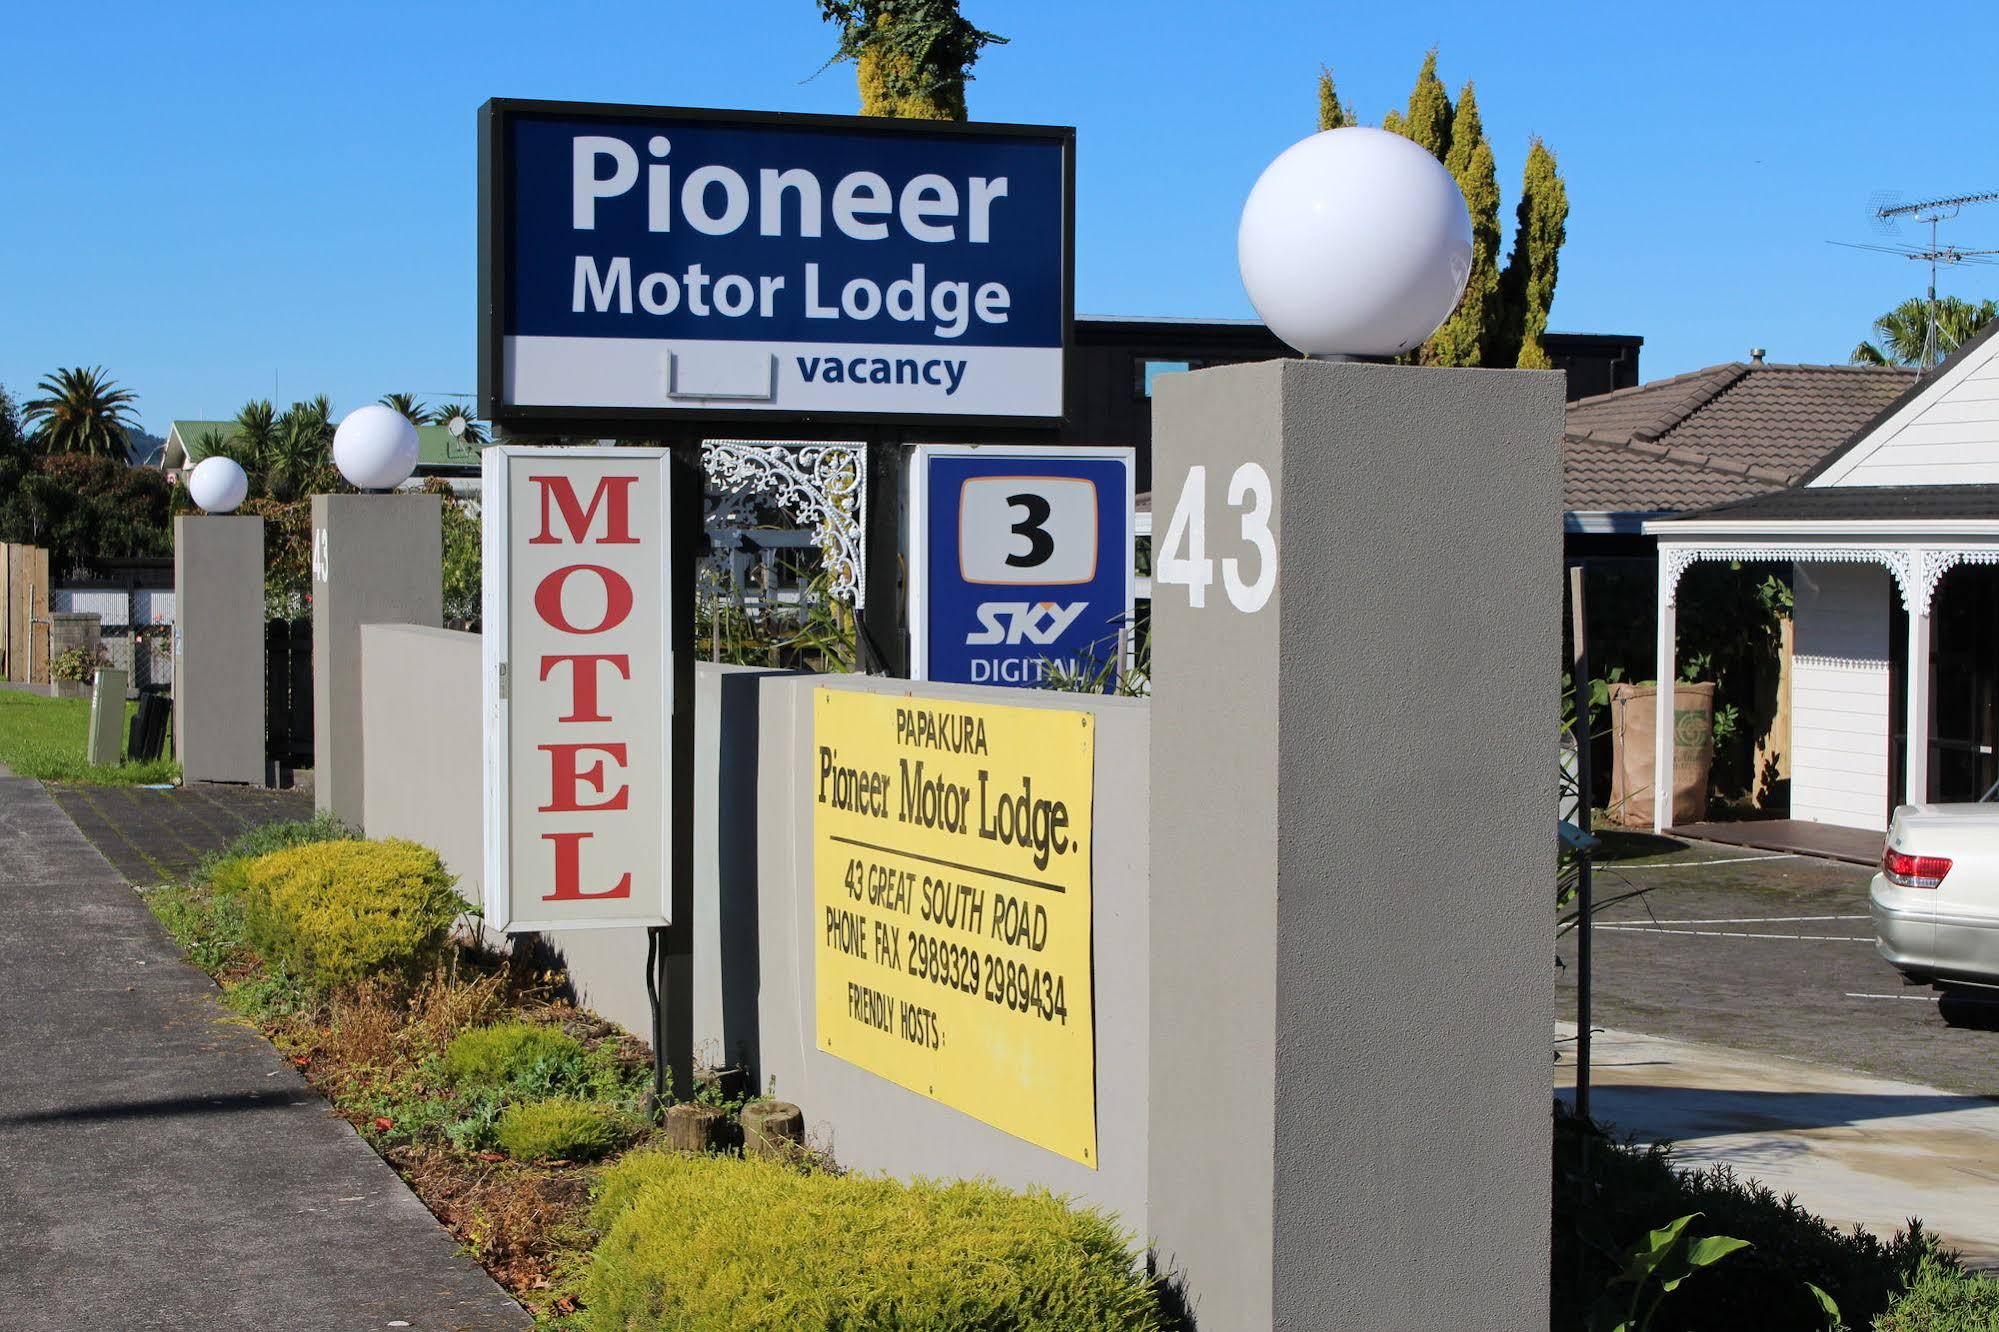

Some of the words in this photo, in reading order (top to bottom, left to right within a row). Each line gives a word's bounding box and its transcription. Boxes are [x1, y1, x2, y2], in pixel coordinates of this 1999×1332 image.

[572, 136, 1008, 243] Pioneer
[571, 255, 785, 317] Motor
[804, 263, 1011, 339] Lodge
[796, 355, 968, 396] vacancy
[312, 528, 329, 582] 43
[1004, 493, 1055, 568] 3
[1156, 462, 1277, 613] 43
[965, 601, 1090, 645] SKY
[528, 476, 641, 902] MOTEL
[896, 708, 988, 756] PAPAKURA
[818, 746, 891, 819] Pioneer
[898, 758, 971, 835] Motor
[844, 859, 864, 901] 43
[867, 863, 917, 915] GREAT
[920, 876, 985, 935] SOUTH
[991, 893, 1048, 952] ROAD
[826, 905, 868, 960] PHONE
[875, 921, 902, 972] FAX
[908, 931, 980, 995] 2989329
[984, 956, 1068, 1026] 2989434
[848, 981, 894, 1034] FRIENDLY
